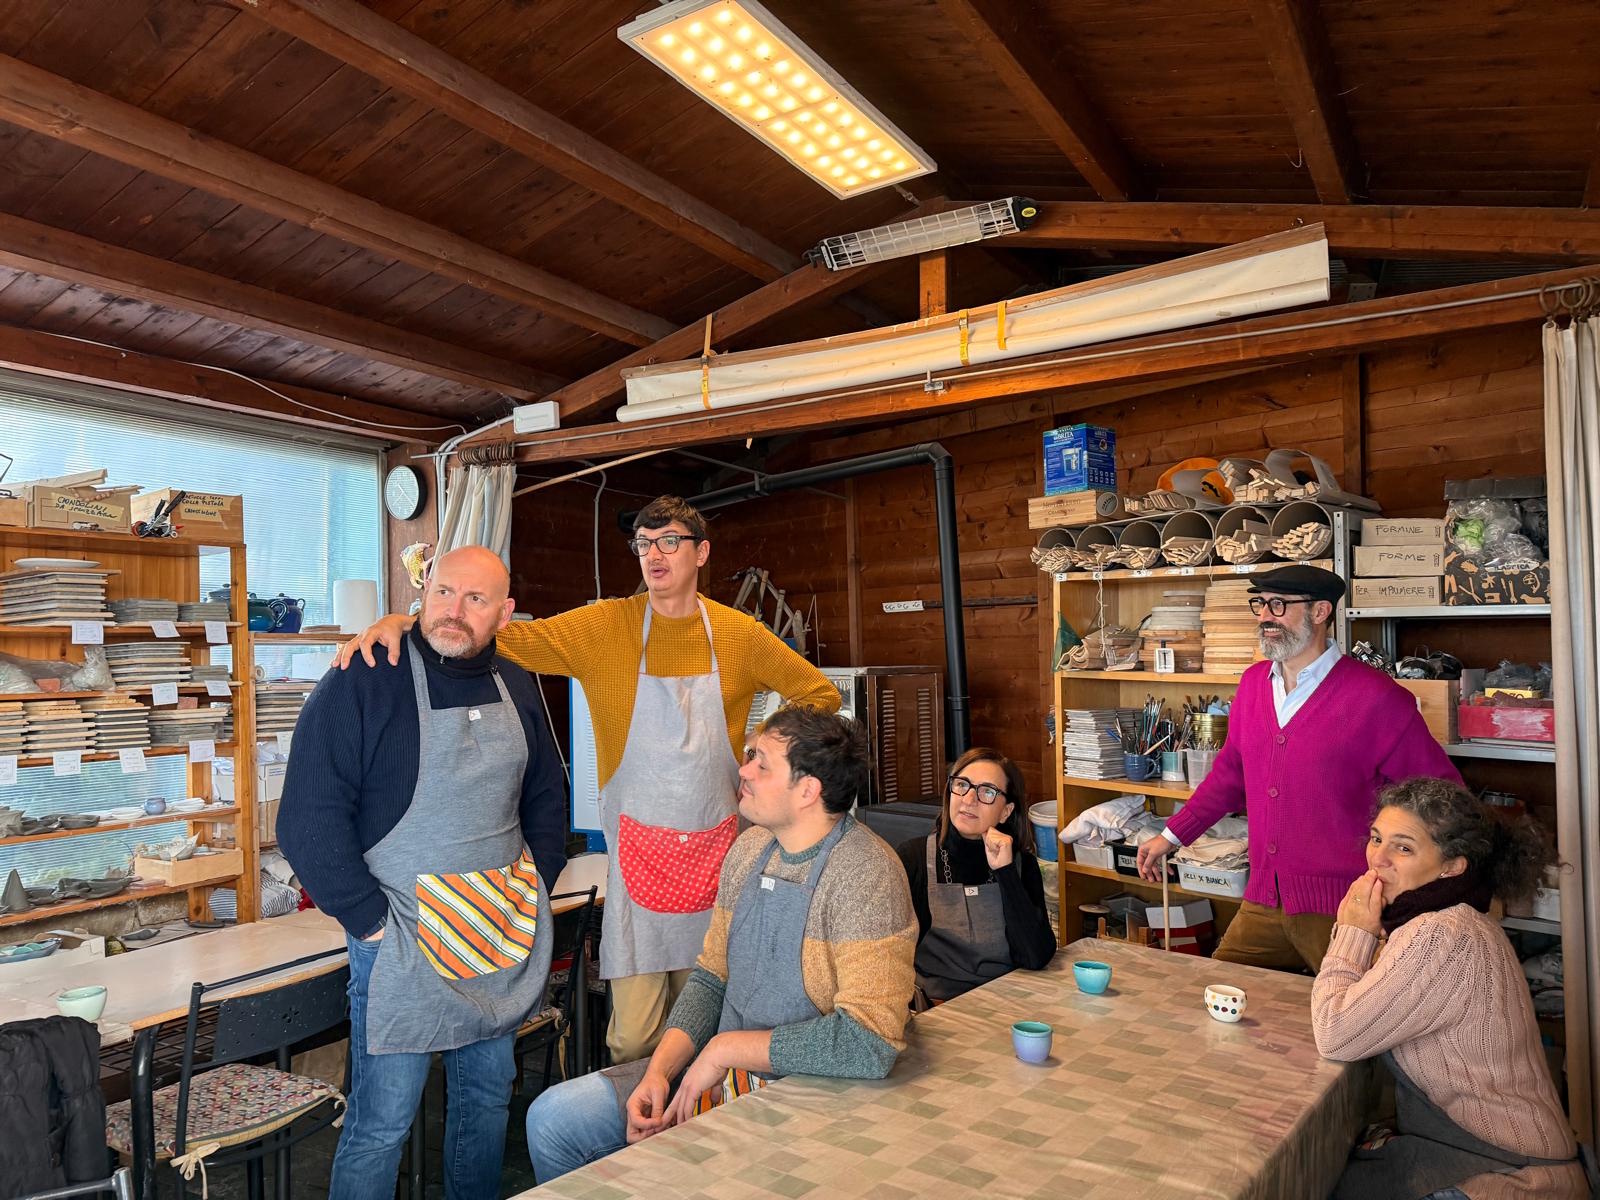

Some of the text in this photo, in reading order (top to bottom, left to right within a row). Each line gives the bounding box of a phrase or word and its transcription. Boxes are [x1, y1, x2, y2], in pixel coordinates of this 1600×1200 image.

[1376, 524, 1424, 536] FORMINE
[1378, 552, 1426, 562] FORME
[1355, 585, 1369, 595] PER
